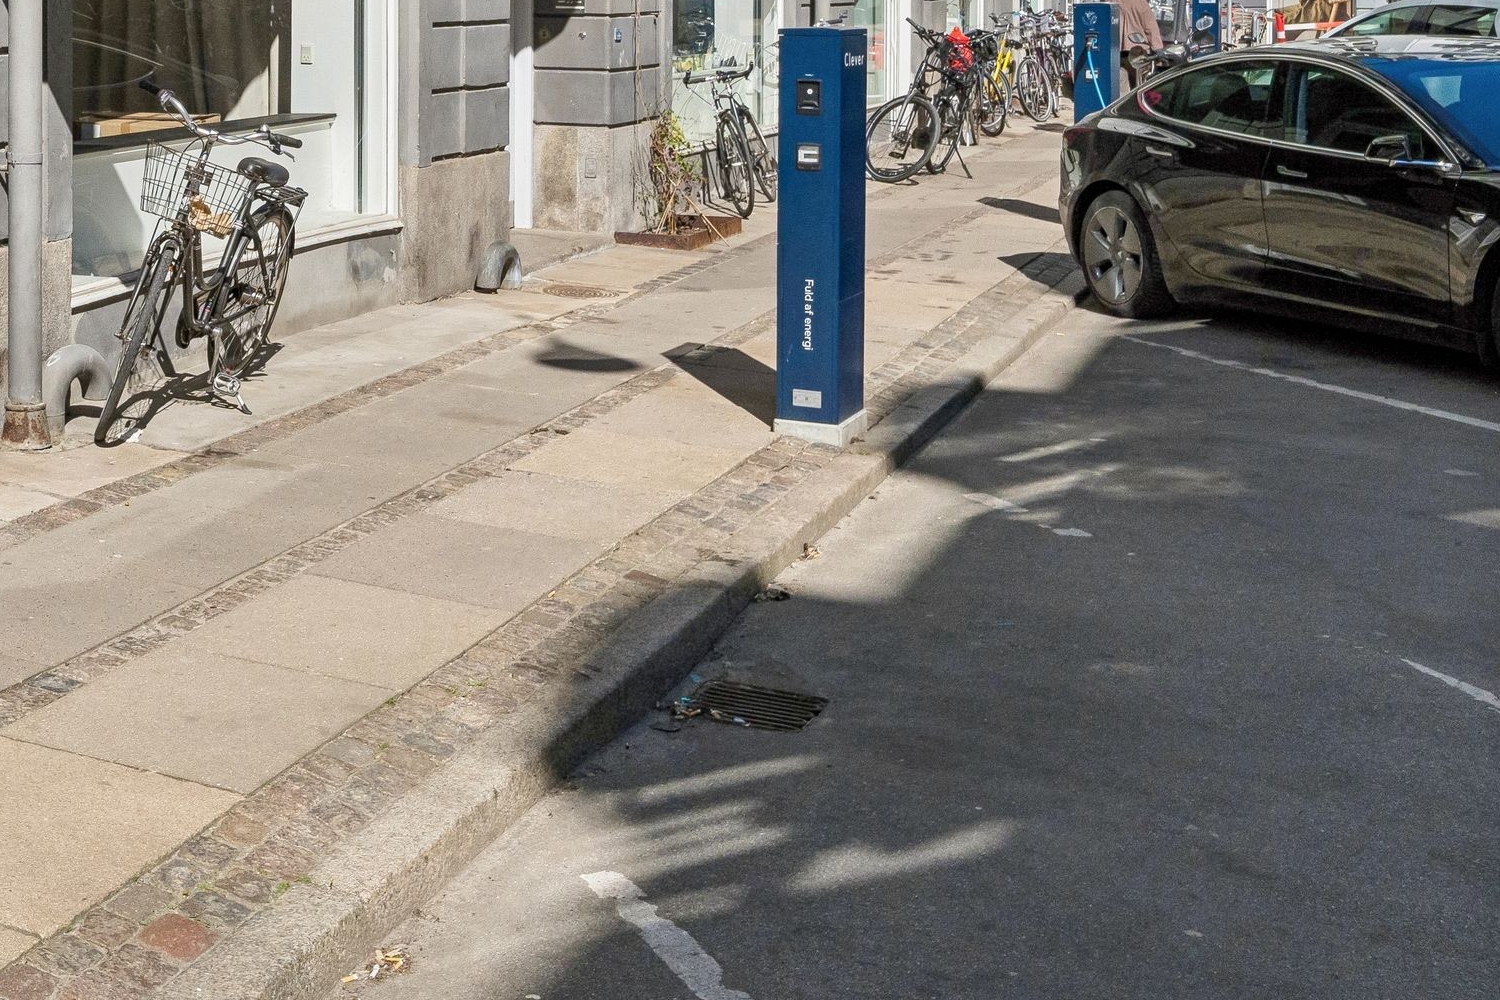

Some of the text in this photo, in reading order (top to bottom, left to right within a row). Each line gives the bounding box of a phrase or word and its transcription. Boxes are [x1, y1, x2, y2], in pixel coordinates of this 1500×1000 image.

[844, 52, 865, 67] Clever
[801, 279, 815, 351] Fuld af energi
